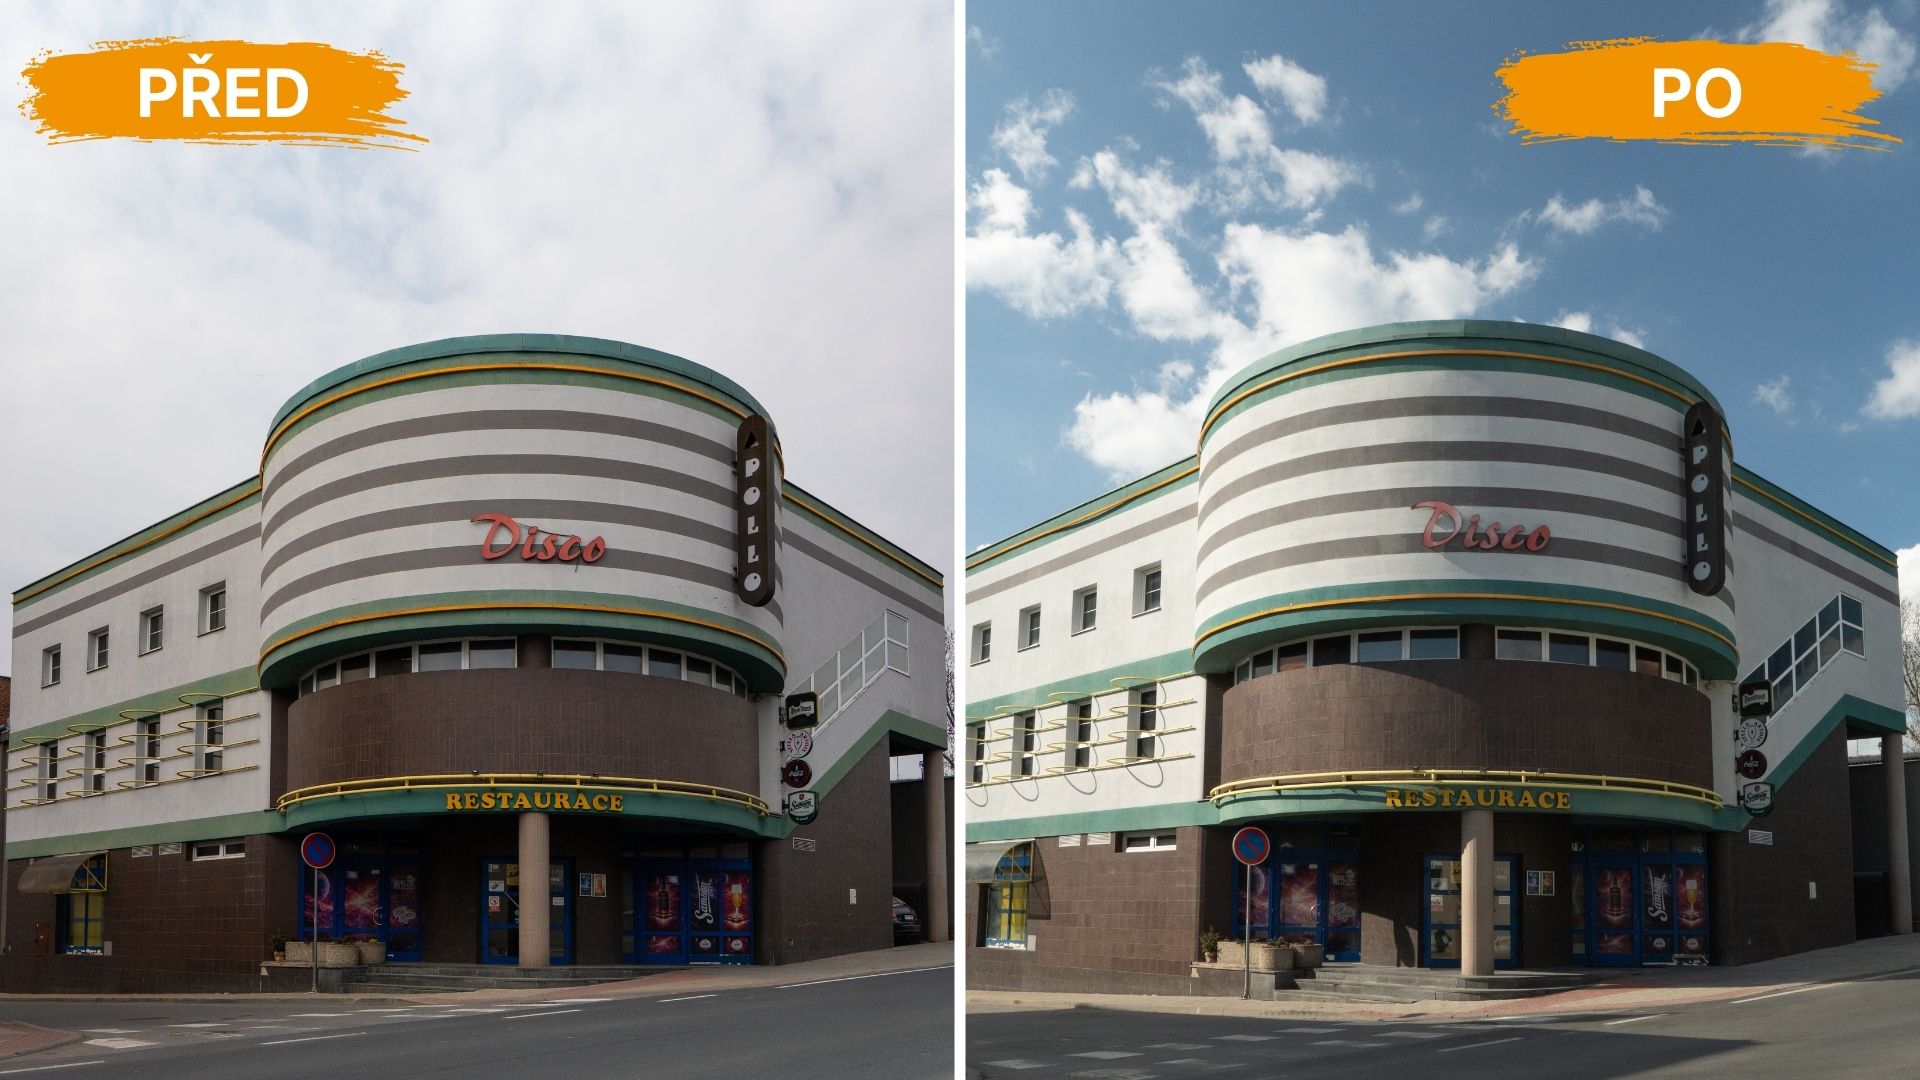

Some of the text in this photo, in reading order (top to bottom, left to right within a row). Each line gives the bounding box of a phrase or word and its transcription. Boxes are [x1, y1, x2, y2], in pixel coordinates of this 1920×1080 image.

[470, 512, 605, 563] Disco
[1411, 501, 1550, 551] Disco
[446, 792, 624, 812] RESTAURACE
[1385, 789, 1571, 809] RESTAURACE
[695, 873, 714, 924] Samson
